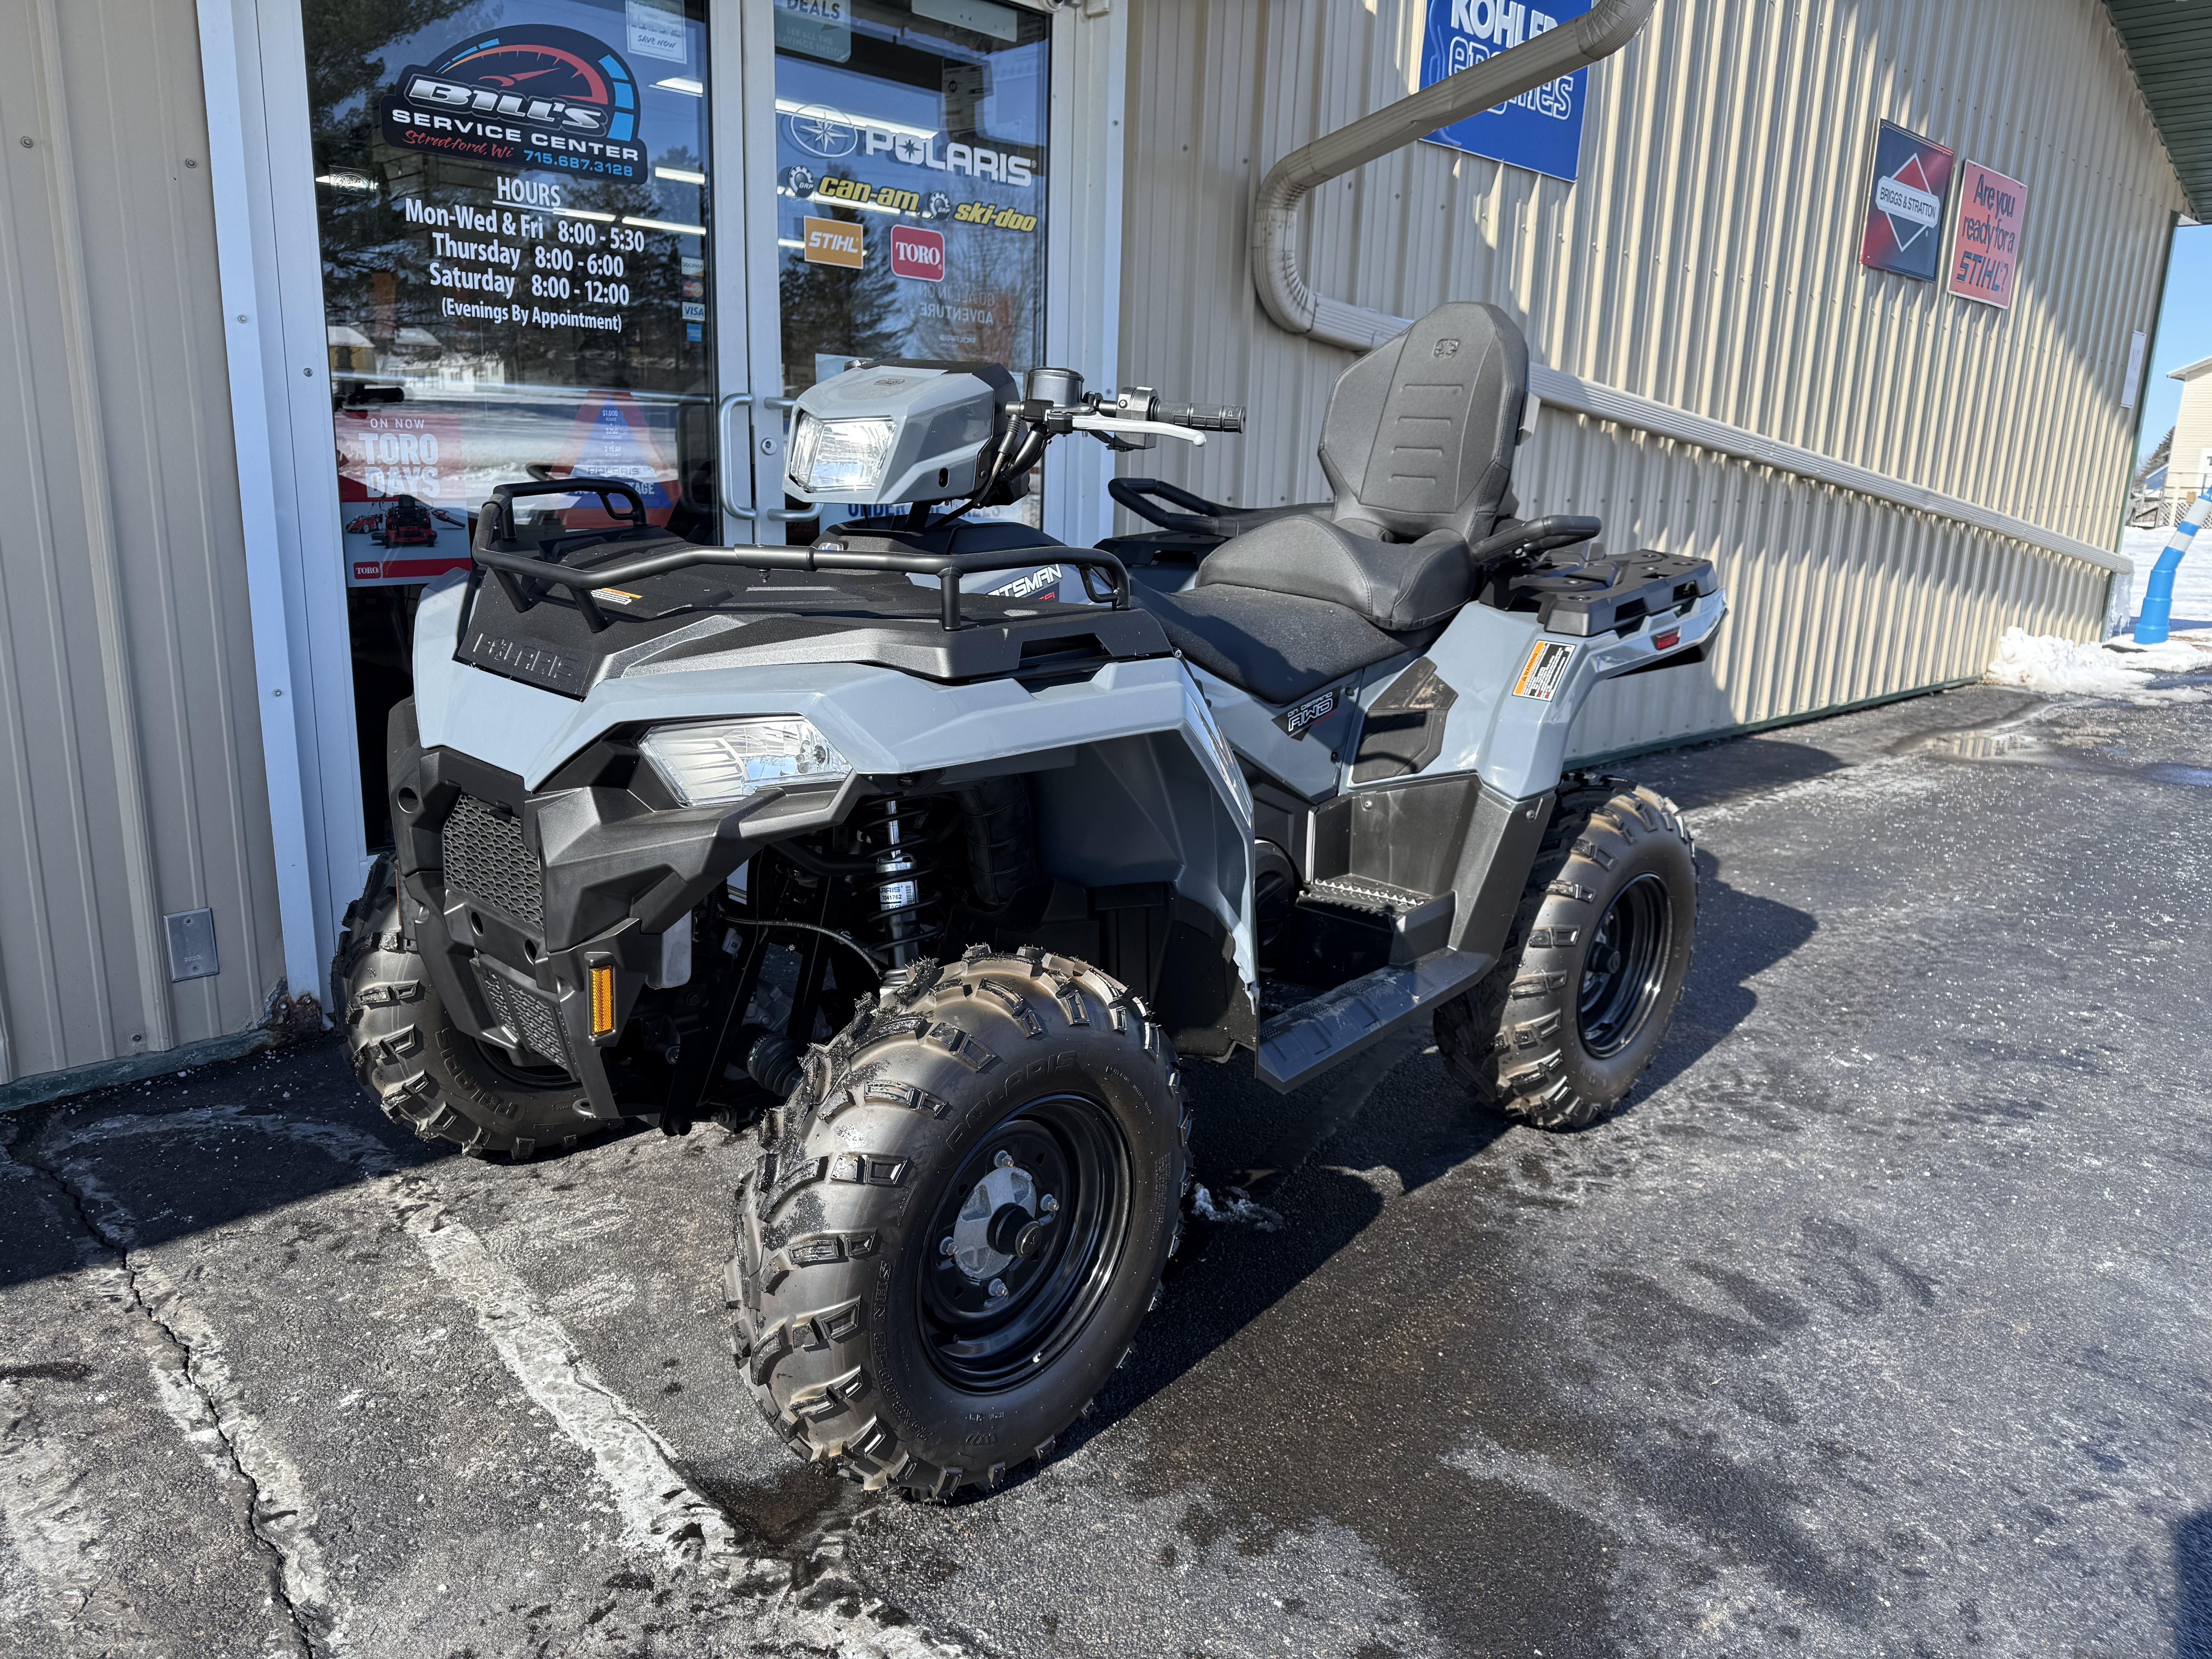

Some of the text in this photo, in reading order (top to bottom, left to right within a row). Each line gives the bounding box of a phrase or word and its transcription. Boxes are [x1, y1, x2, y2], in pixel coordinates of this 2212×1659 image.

[787, 0, 840, 19] DEALS
[638, 35, 655, 45] SAVE
[657, 40, 676, 48] NOW
[392, 109, 638, 161] SERVICE CENTER
[524, 149, 633, 177] 715.687.3128
[866, 124, 1032, 187] POLARIS
[497, 176, 561, 207] HOURS
[819, 176, 920, 211] can-am
[1880, 187, 1936, 219] BRIGGS & STRATTON
[1973, 174, 2015, 220] Are you
[405, 198, 497, 233] Mon-Wed
[503, 212, 516, 236] &
[521, 214, 544, 239] Fri
[558, 220, 596, 246] 8:00
[610, 227, 645, 252] 5:30
[954, 202, 1038, 232] ski-doo
[809, 230, 859, 254] STIHL
[1962, 214, 2015, 254] ready for a
[432, 232, 521, 271] Thursday
[535, 246, 573, 271] 8:00
[587, 253, 624, 277] 6:00
[896, 241, 941, 266] TORO
[429, 262, 515, 299] Saturday
[532, 274, 570, 299] 8:00
[585, 280, 630, 305] 12:00
[442, 297, 622, 333] (Evenings By Appointment)
[685, 306, 704, 316] VISA
[370, 418, 424, 429] ON NOW
[359, 433, 438, 465] TORO
[365, 466, 440, 498] DAYS
[588, 467, 639, 476] POLARIS
[473, 633, 579, 678] POLARIS
[1288, 708, 1298, 717] ON
[1288, 698, 1333, 732] AWD
[435, 1027, 518, 1120] POLARIS
[946, 1050, 1078, 1152] POLARIS
